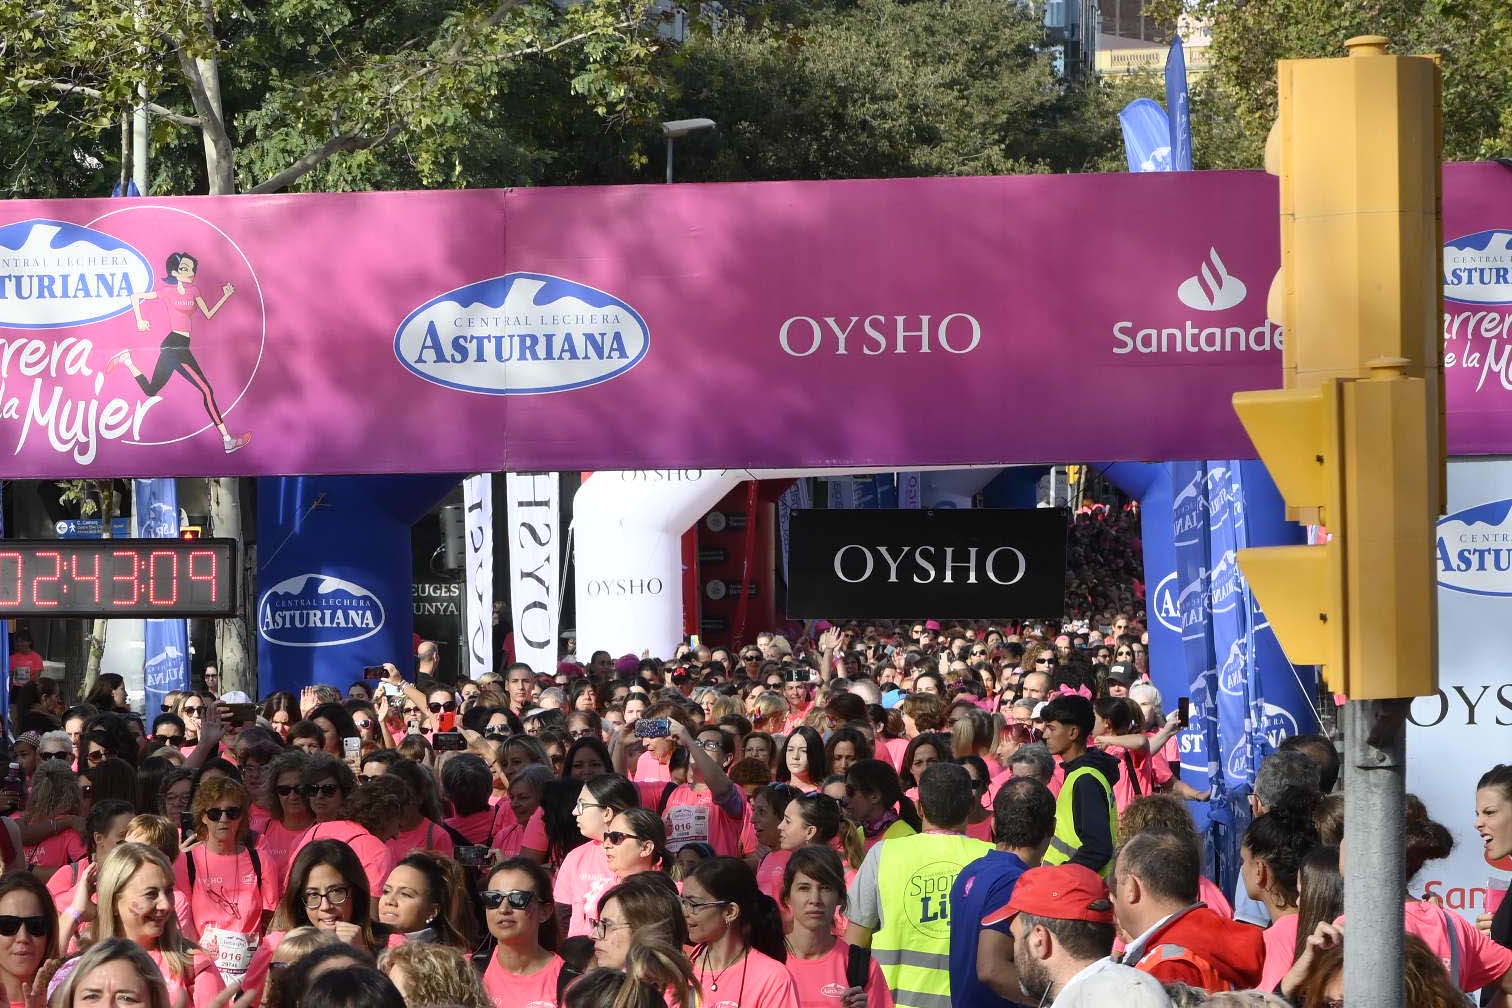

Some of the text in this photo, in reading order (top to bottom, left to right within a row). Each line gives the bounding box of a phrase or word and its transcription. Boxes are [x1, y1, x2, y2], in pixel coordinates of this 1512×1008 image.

[57, 255, 128, 268] LECHERA
[454, 312, 622, 329] CENTRAL LECHERA
[779, 312, 982, 357] OYSHO
[414, 319, 630, 365] ASTURIANA
[1462, 340, 1481, 368] la
[14, 371, 164, 465] Mujer
[834, 543, 1026, 586] OYSHO
[587, 577, 663, 596] OYSHO
[263, 603, 375, 631] ASTURIANA
[322, 599, 371, 607] LECHERA
